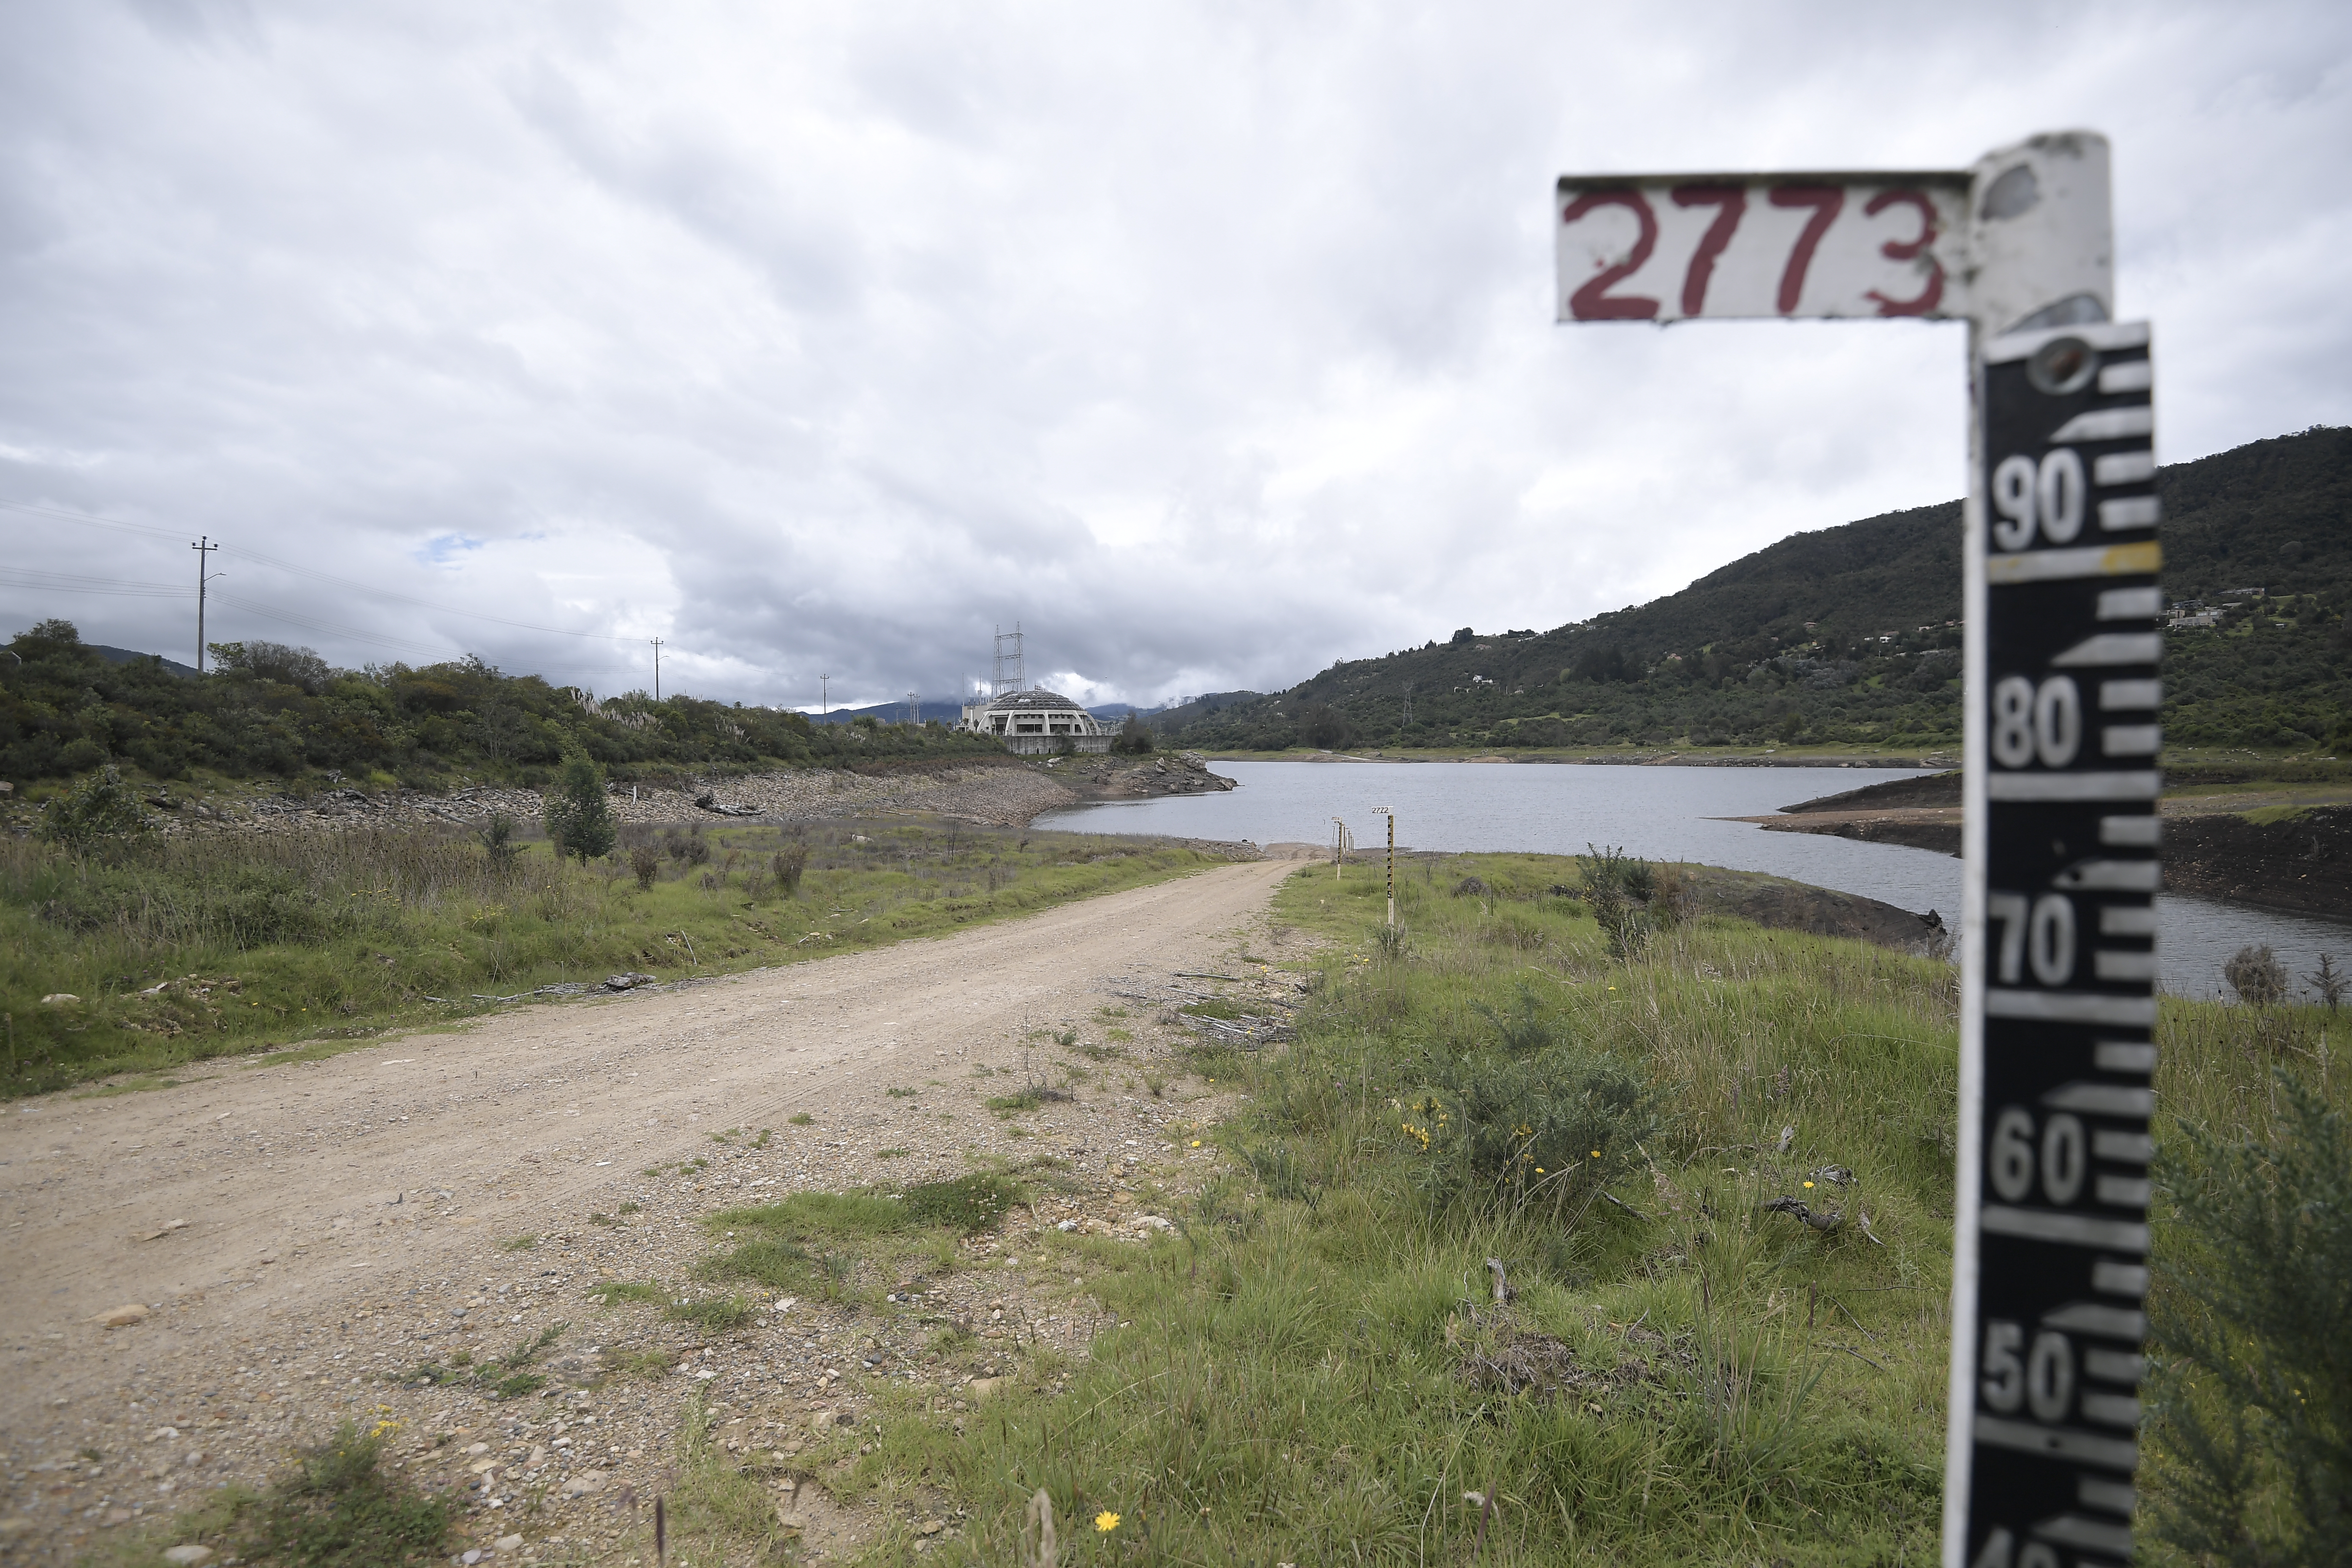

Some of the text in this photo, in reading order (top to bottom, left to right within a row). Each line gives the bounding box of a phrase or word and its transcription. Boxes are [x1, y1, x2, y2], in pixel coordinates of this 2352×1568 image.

[1563, 185, 1944, 319] 2773
[1992, 447, 2086, 551] 90
[1992, 675, 2081, 768] 80
[1987, 891, 2076, 986] 70
[1988, 1106, 2086, 1206] 60
[1980, 1317, 2075, 1423] 50
